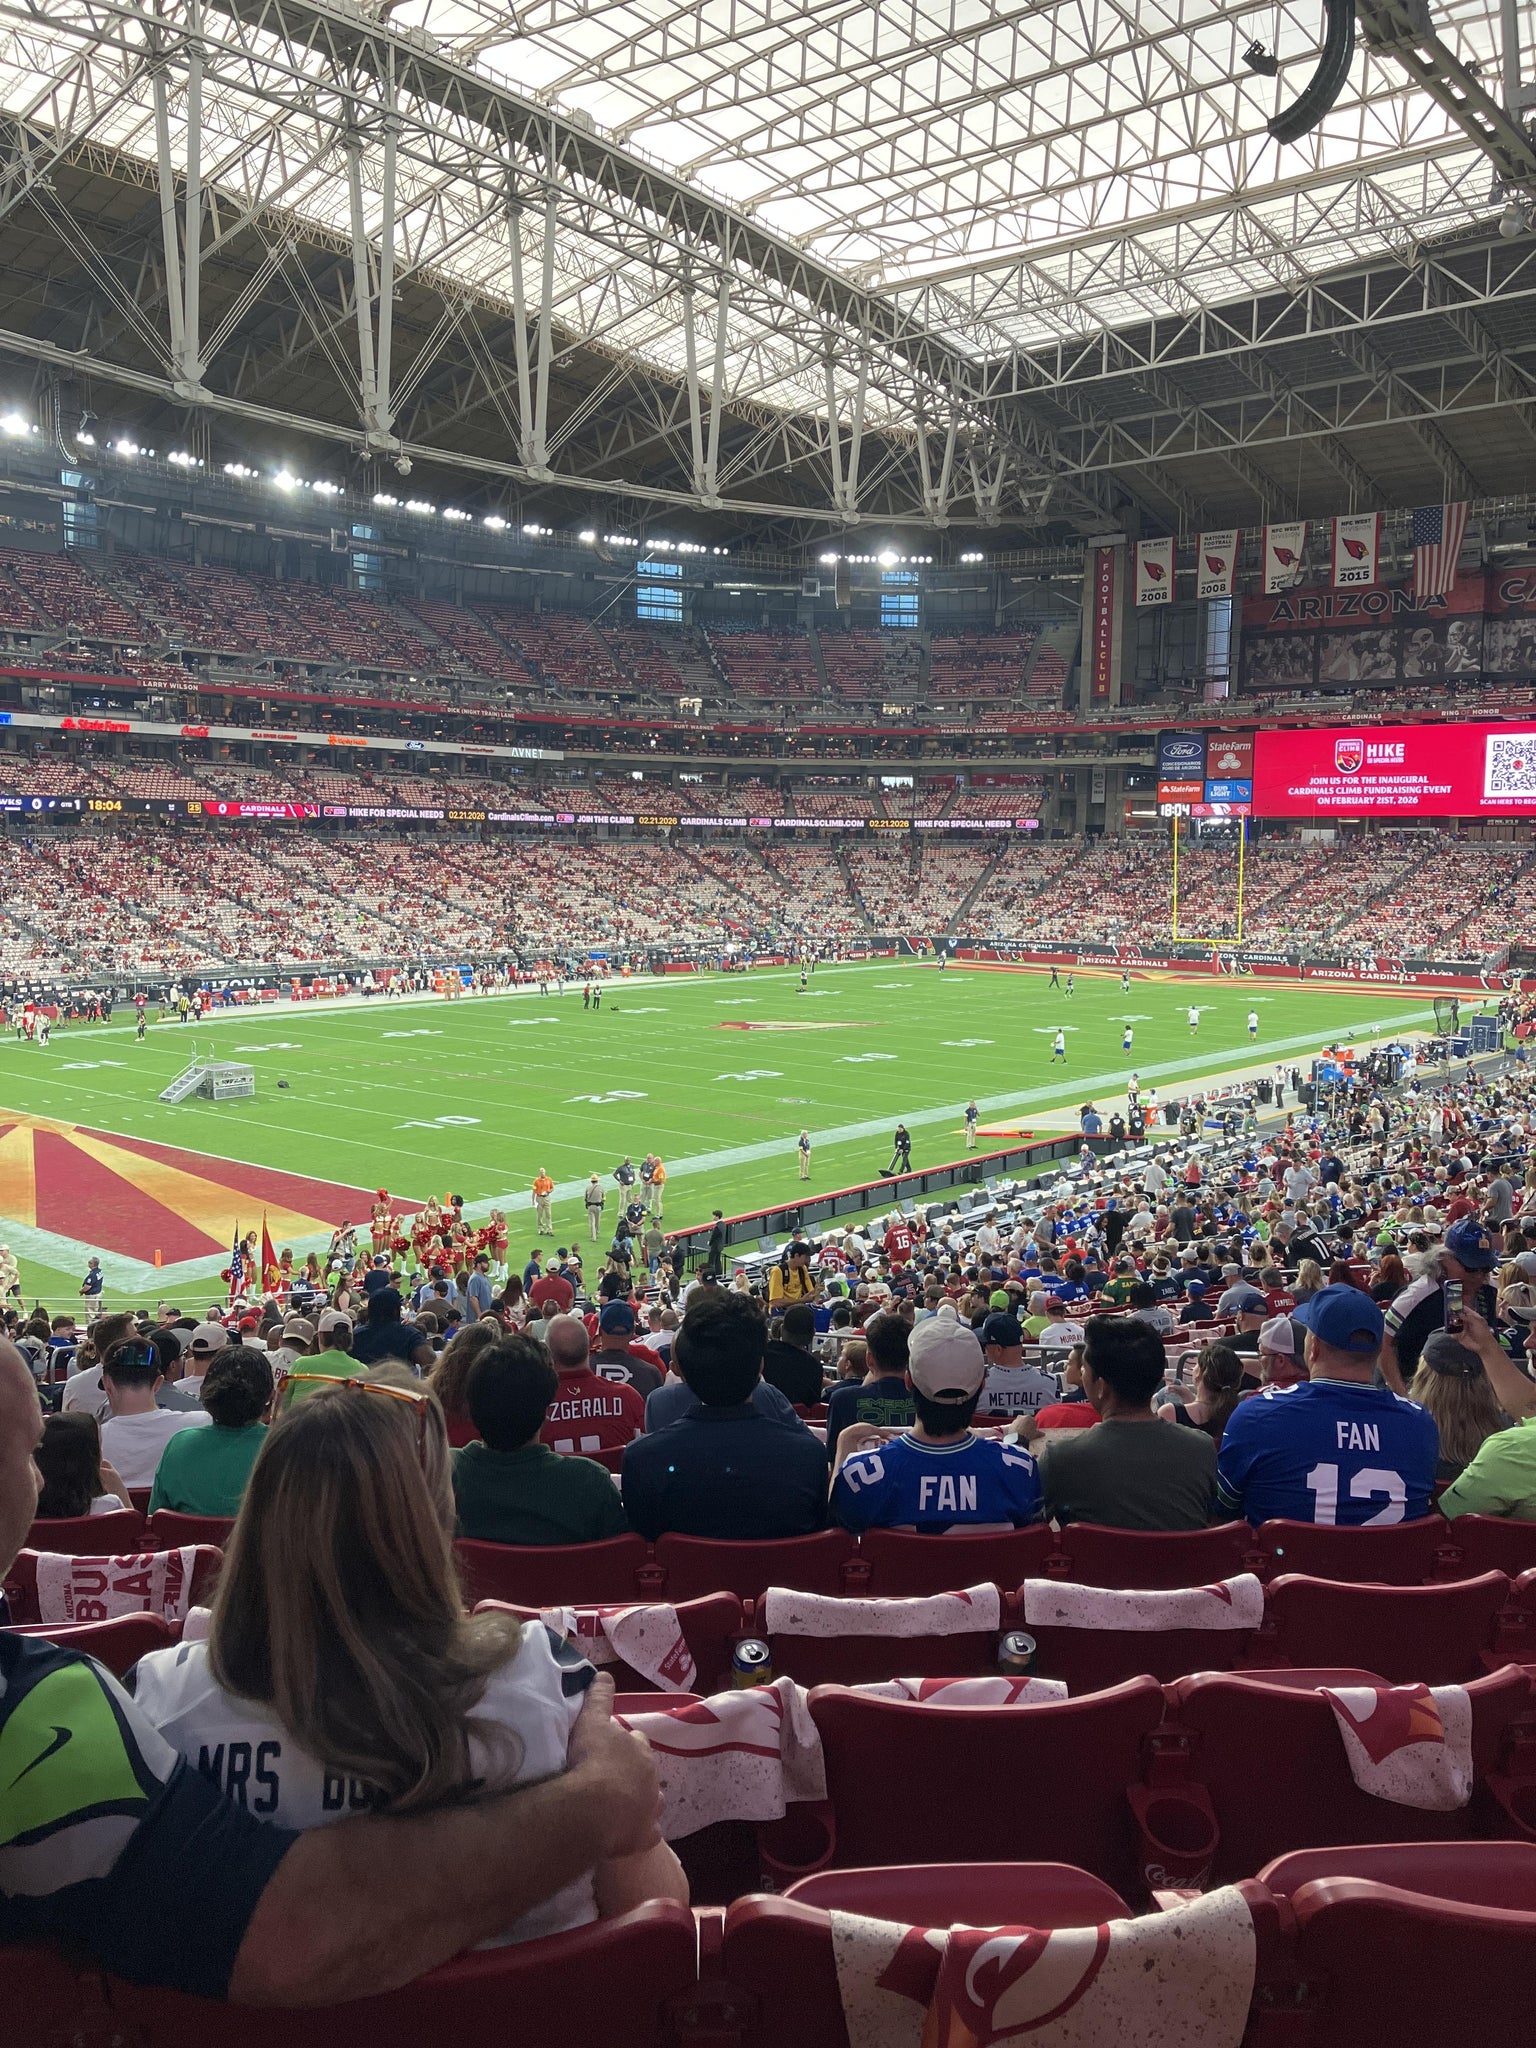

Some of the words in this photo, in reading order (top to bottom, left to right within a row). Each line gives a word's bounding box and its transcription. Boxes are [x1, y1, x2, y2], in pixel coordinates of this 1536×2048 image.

[1339, 571, 1370, 582] 2015
[1200, 584, 1226, 595] 2008
[1140, 592, 1168, 602] 2008
[1270, 589, 1448, 623] ARIZONA
[142, 681, 168, 689] LARRY
[169, 683, 199, 691] WILSON
[511, 747, 544, 758] AVNET
[1170, 744, 1195, 755] Ford
[1366, 743, 1405, 757] HIKE
[1309, 777, 1329, 785] JOIN
[1330, 776, 1341, 785] US
[1342, 776, 1360, 785] FOR
[1361, 776, 1377, 784] THE
[1378, 775, 1429, 784] INAUGURAL
[1287, 787, 1334, 795] CARDINALS
[1335, 786, 1363, 795] CLIMB
[1363, 786, 1422, 794] FUNDRAISING
[1423, 785, 1452, 794] EVENT
[31, 797, 42, 810] 0
[88, 800, 122, 811] 18:04
[1317, 797, 1331, 805] ON
[1331, 796, 1375, 805] FEBRUARY
[1397, 796, 1419, 805] 2026
[218, 803, 227, 814] 0
[240, 805, 286, 813] CARDINALS
[1160, 803, 1190, 816] 18:04
[349, 808, 369, 817] HIKE
[369, 808, 386, 818] FOR
[386, 809, 419, 819] SPECIAL
[419, 810, 445, 819] NEEDS
[448, 811, 485, 821] 02.21.2026
[488, 812, 554, 823] CardinalsClimb.com
[576, 815, 594, 823] JOIN
[594, 815, 609, 824] THE
[609, 816, 635, 824] CLIMB
[638, 816, 678, 825] 02.21.2026
[680, 817, 723, 826] CARDINALS
[723, 817, 747, 826] CLIMB
[774, 818, 864, 827] CARDINALSCLIMB.COM
[869, 819, 910, 828] 02.21.2026
[914, 820, 933, 828] HIKE
[933, 820, 950, 828] FOR
[950, 820, 984, 828] SPECIAL
[984, 819, 1012, 828] NEEDS
[1120, 958, 1168, 968] CARDINALS
[1242, 954, 1288, 962] CARDINALS
[1310, 969, 1356, 979] ARIZONA
[562, 1090, 649, 1104] 20
[392, 1115, 482, 1130] 10
[895, 1235, 909, 1250] 16
[1273, 1298, 1295, 1308] CAMPBELL
[988, 1391, 1043, 1407] METCALF
[549, 1397, 623, 1423] ZGERALD
[1336, 1420, 1380, 1451] FAN
[919, 1475, 977, 1511] FAN
[1306, 1462, 1409, 1527] 12
[63, 1582, 74, 1620] ARIZONA
